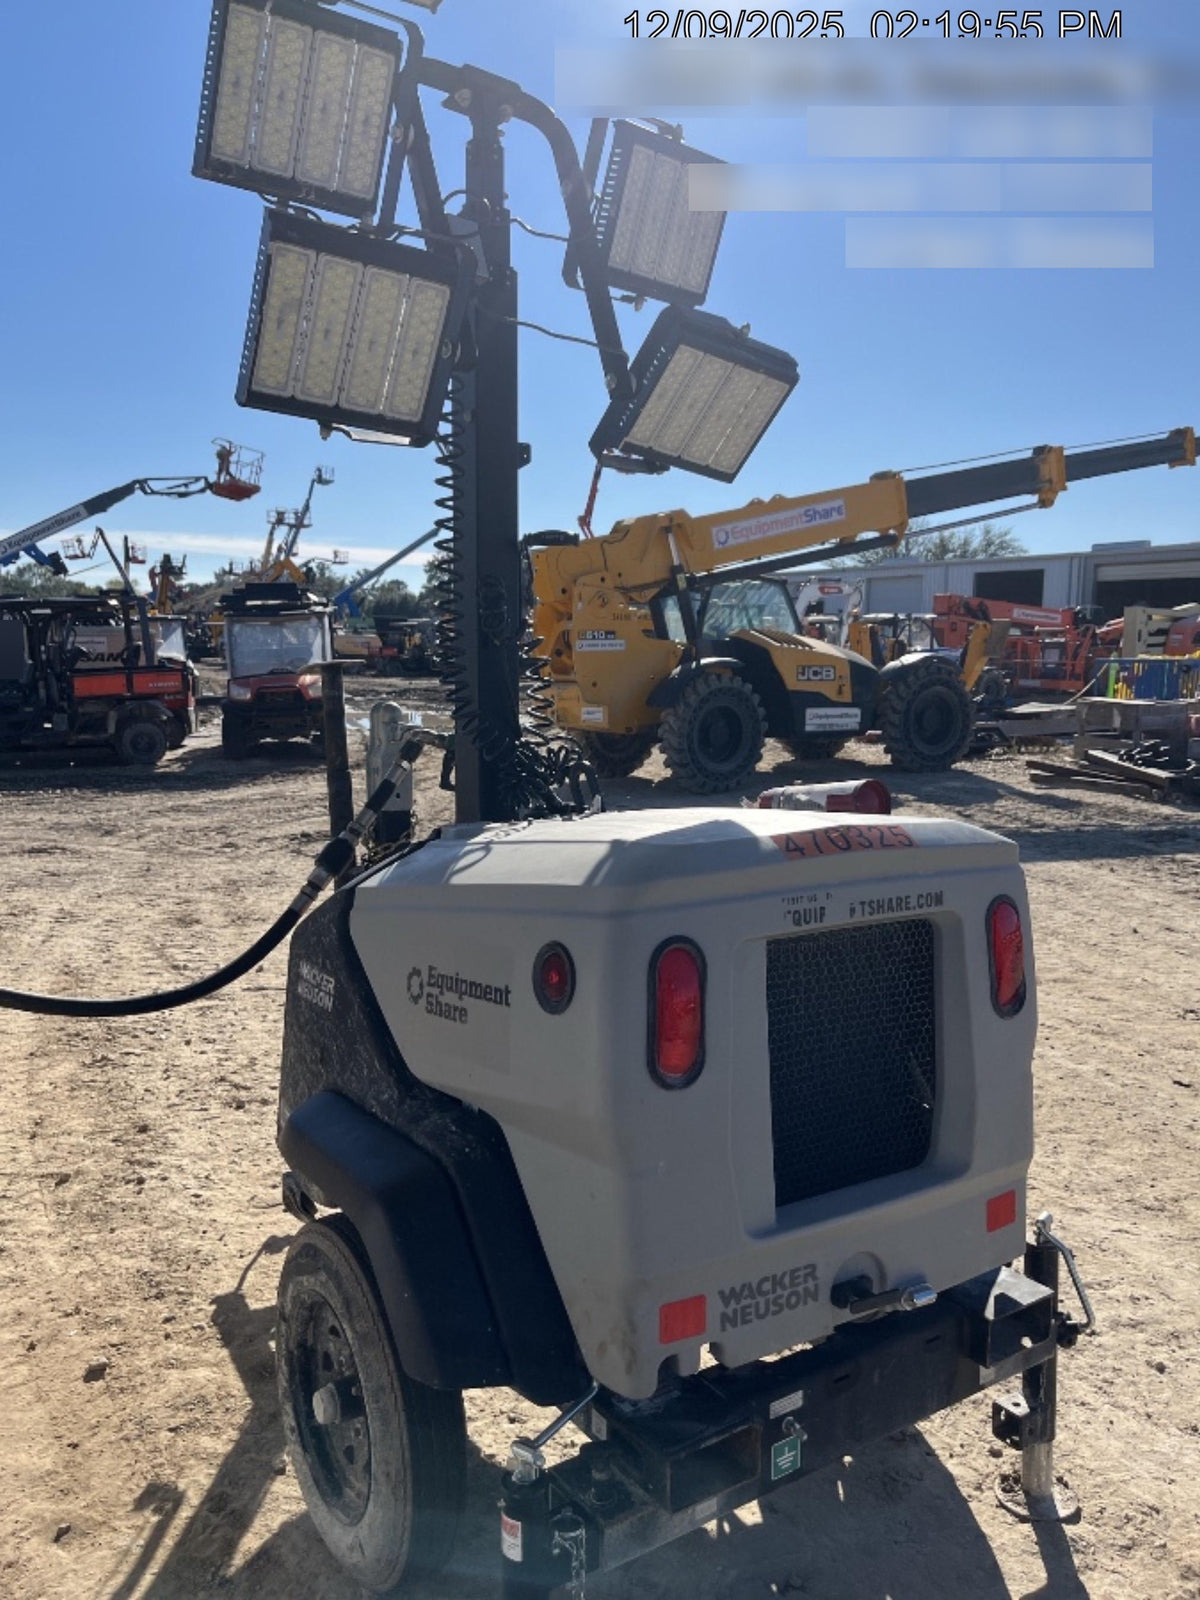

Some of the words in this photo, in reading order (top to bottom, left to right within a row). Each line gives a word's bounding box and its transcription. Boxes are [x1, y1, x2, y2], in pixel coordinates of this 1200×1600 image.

[731, 503, 844, 540] EquipmentShare
[797, 666, 836, 681] JCB
[784, 825, 914, 856] 470325
[426, 964, 511, 1007] Equipment
[425, 992, 468, 1025] Share
[718, 1263, 818, 1309] WACKER
[720, 1282, 819, 1332] NEUSON
